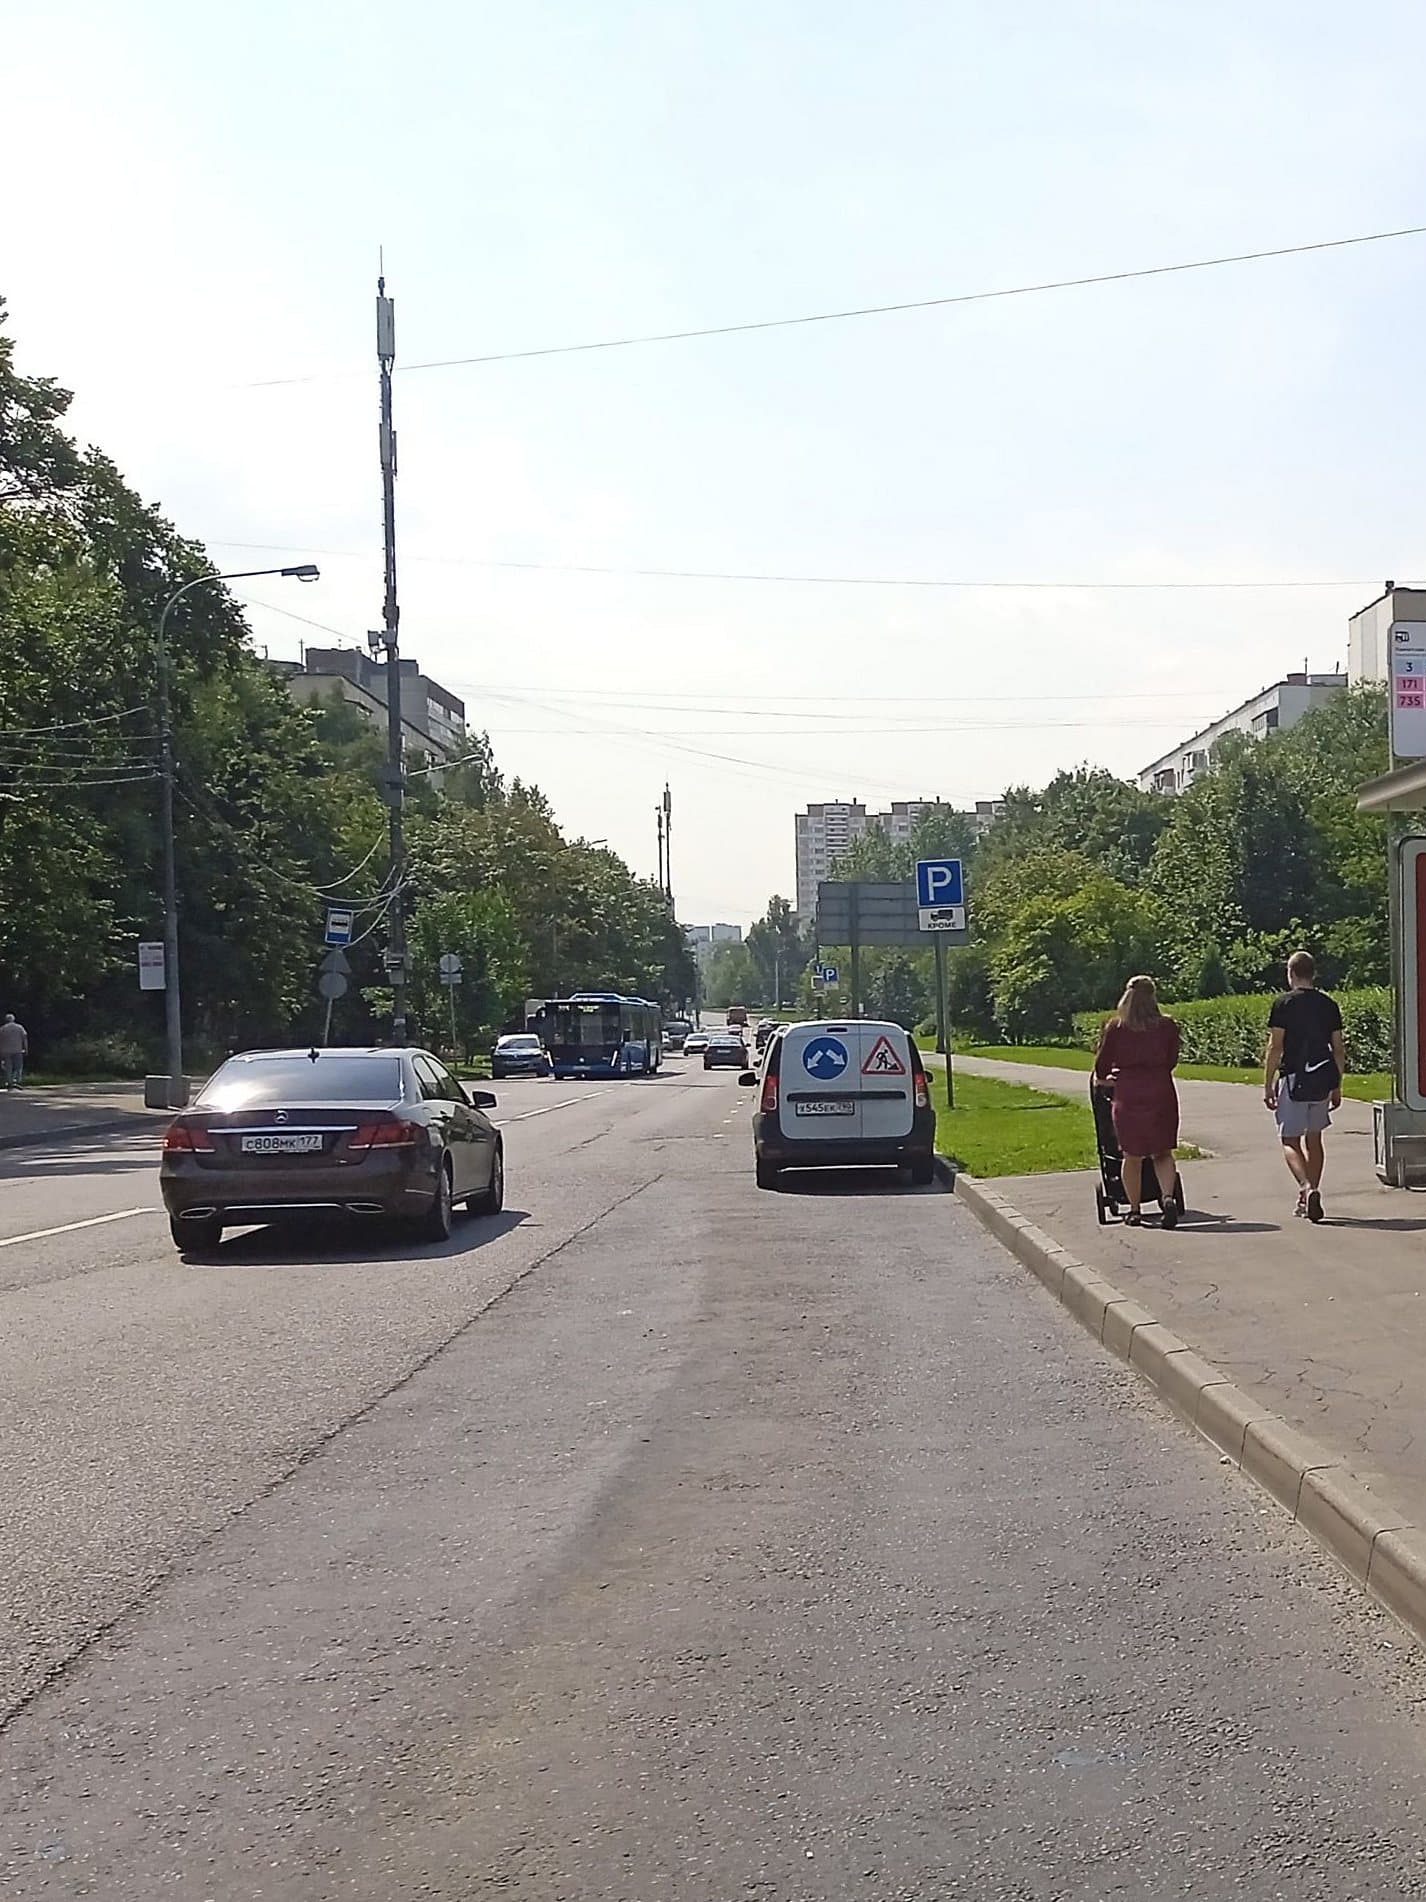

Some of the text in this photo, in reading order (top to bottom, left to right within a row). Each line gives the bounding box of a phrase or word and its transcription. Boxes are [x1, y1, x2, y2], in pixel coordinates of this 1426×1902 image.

[1405, 662, 1413, 673] 3
[1402, 679, 1418, 689] 171
[1399, 696, 1421, 706] 735
[927, 866, 953, 902] P
[927, 921, 958, 930] КРОМЕ
[826, 969, 835, 981] P
